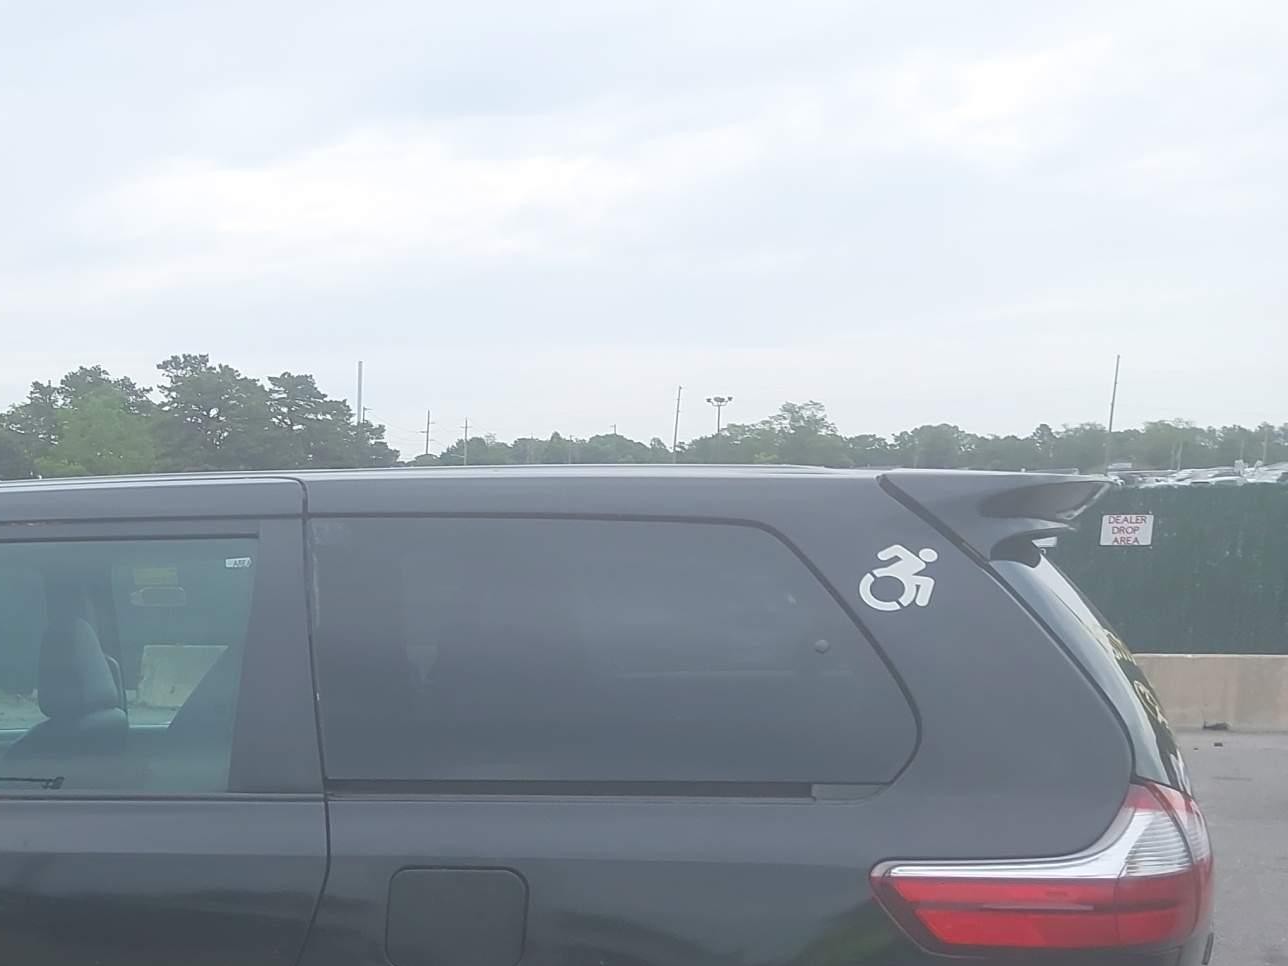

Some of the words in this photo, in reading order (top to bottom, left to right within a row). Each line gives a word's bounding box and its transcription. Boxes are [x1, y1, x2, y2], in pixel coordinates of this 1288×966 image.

[1108, 515, 1148, 525] DEALER
[1111, 526, 1140, 535] DROP
[1112, 536, 1140, 545] AREA
